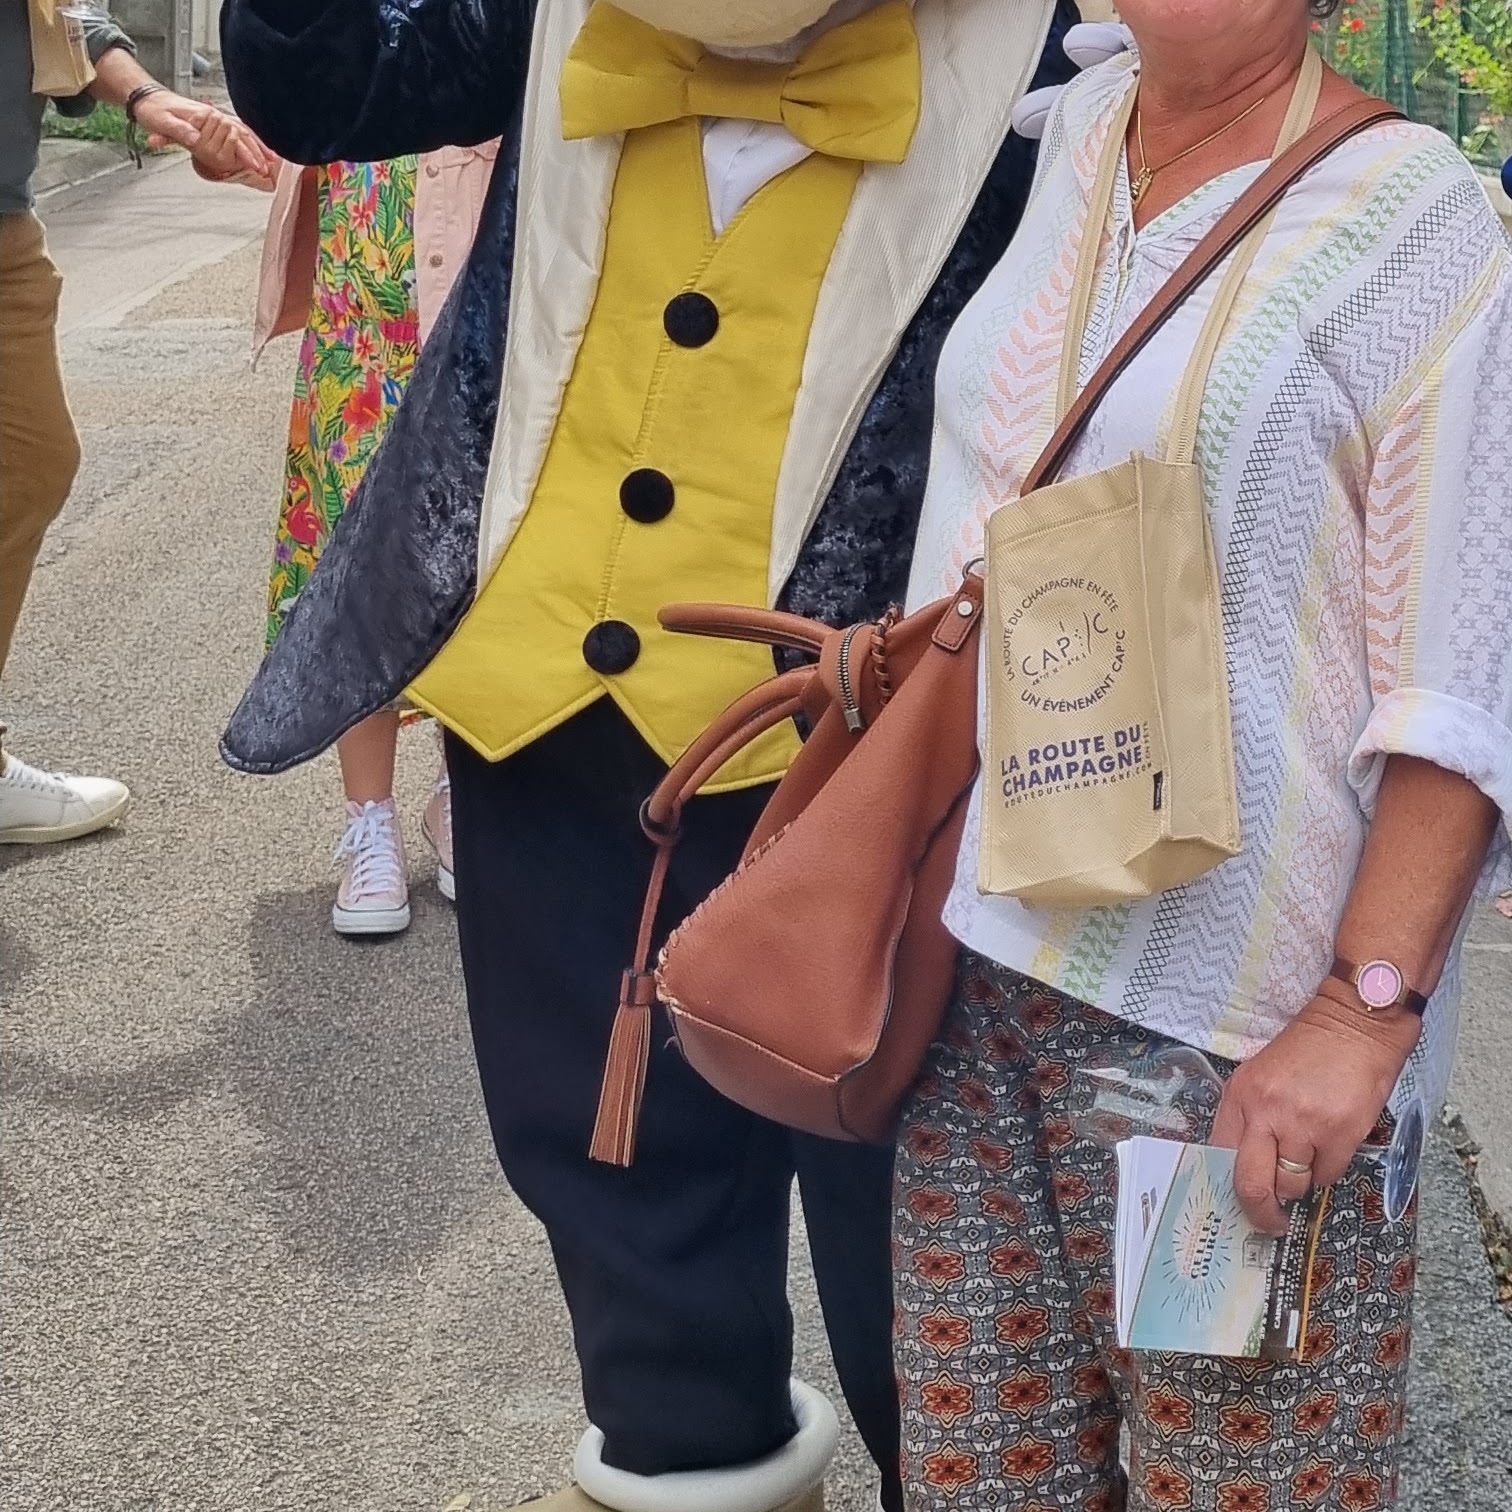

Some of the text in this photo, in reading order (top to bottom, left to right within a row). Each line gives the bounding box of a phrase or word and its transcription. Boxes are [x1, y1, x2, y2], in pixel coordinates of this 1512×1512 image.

[1021, 577, 1085, 609] CHAMPAGNE
[1086, 581, 1102, 595] EN
[1008, 608, 1023, 626] DU
[1003, 628, 1014, 666] ROUTE
[1021, 689, 1041, 708] UN
[1042, 673, 1115, 713] ÉVÉNEMENT
[1111, 629, 1126, 673] CAP'C
[1001, 724, 1142, 777] LA ROUTE DU
[1002, 744, 1142, 797] CHAMPAGNE
[1190, 1210, 1215, 1280] CELLES
